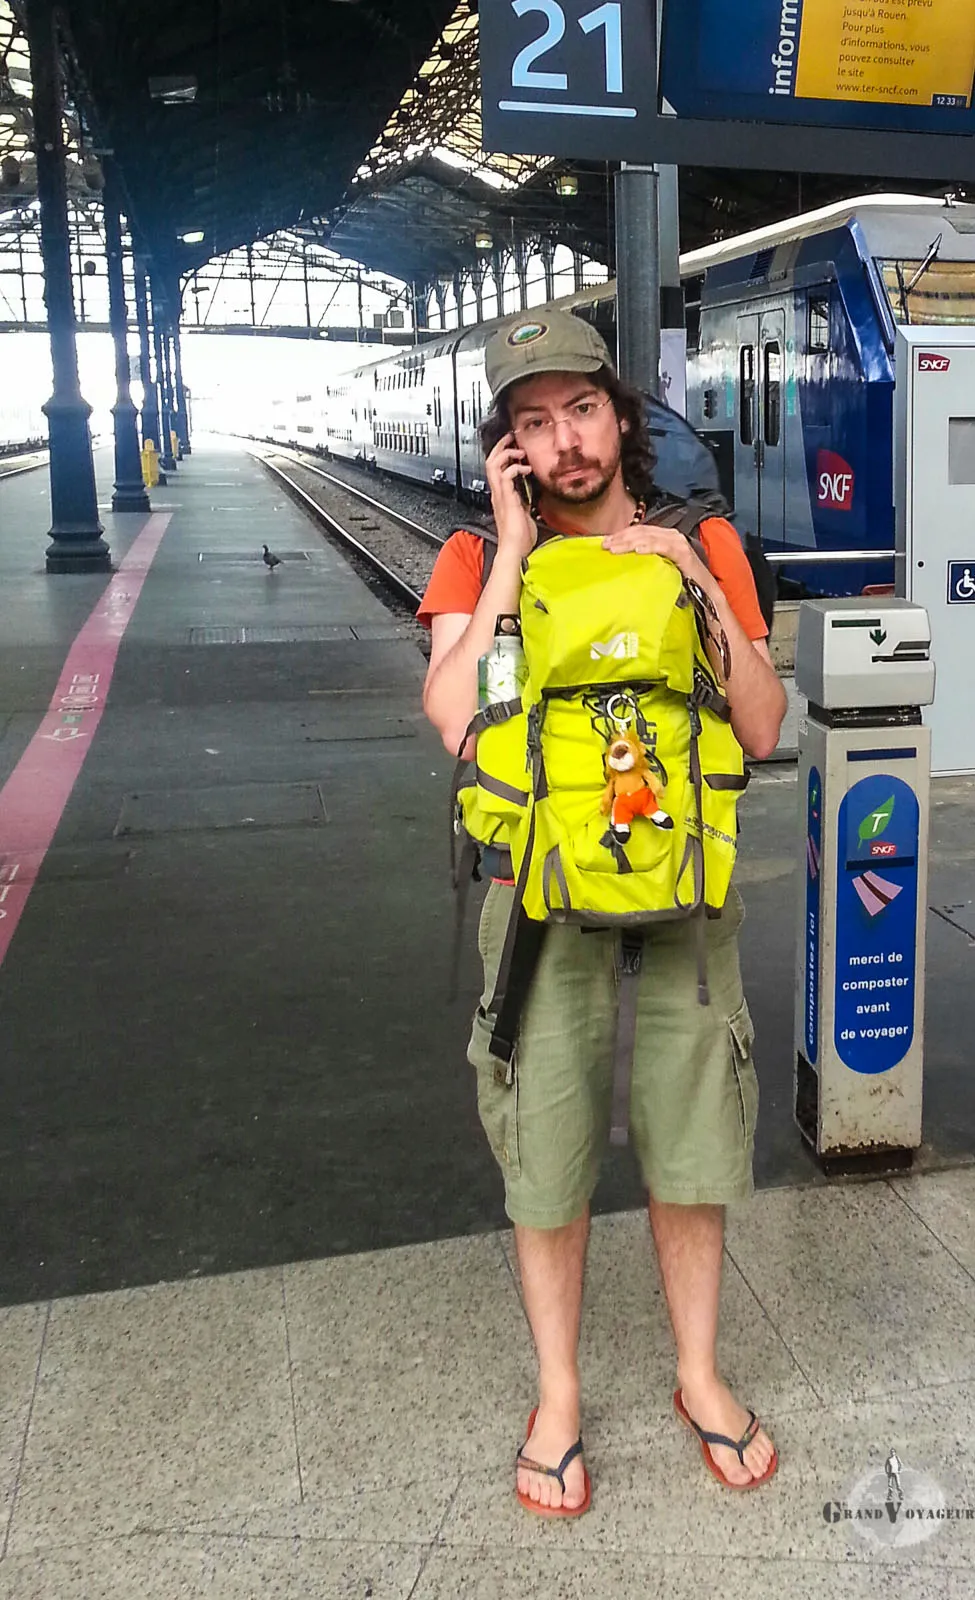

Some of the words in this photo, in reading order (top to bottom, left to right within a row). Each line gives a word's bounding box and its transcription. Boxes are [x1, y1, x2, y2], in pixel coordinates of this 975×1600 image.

[843, 7, 875, 18] jusqu'à
[842, 21, 863, 32] Pour
[865, 24, 884, 35] plus
[510, 0, 625, 93] 21
[840, 38, 908, 52] d'informations,
[910, 44, 930, 52] vous
[838, 53, 871, 63] pouvez
[873, 55, 915, 66] consulter
[837, 67, 846, 76] le
[848, 69, 864, 78] site
[836, 83, 918, 96] www.ter-sncf.com
[919, 360, 949, 369] SNCF
[818, 472, 852, 502] SNCF
[871, 845, 896, 855] SNCF
[849, 952, 884, 966] merci
[887, 951, 903, 963] de
[842, 976, 909, 991] composter
[856, 1001, 890, 1014] avant
[840, 1028, 856, 1040] de
[860, 1025, 909, 1040] voyager
